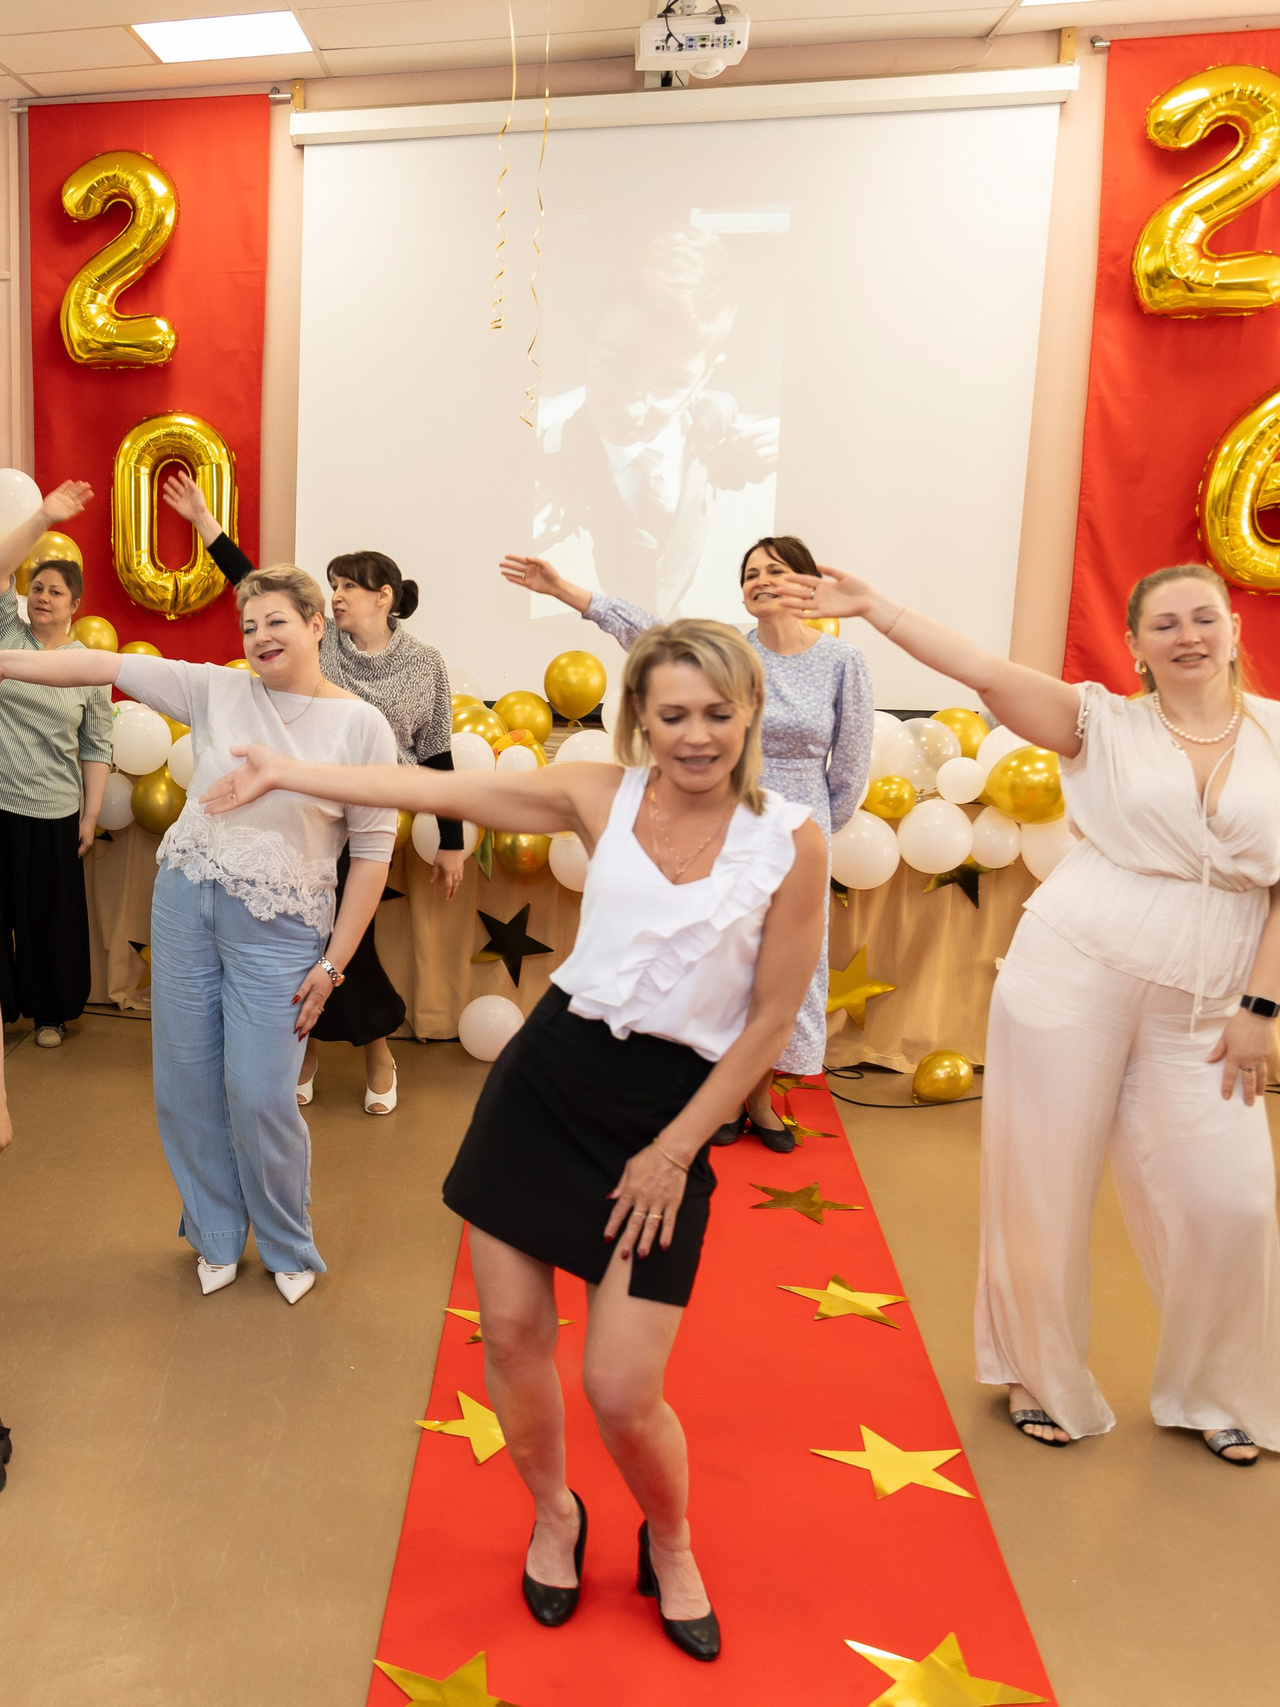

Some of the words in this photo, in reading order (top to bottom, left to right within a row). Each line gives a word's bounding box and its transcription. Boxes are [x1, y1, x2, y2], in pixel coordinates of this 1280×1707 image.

[60, 148, 181, 370] 2
[1131, 63, 1280, 318] 2
[111, 410, 240, 621] 0
